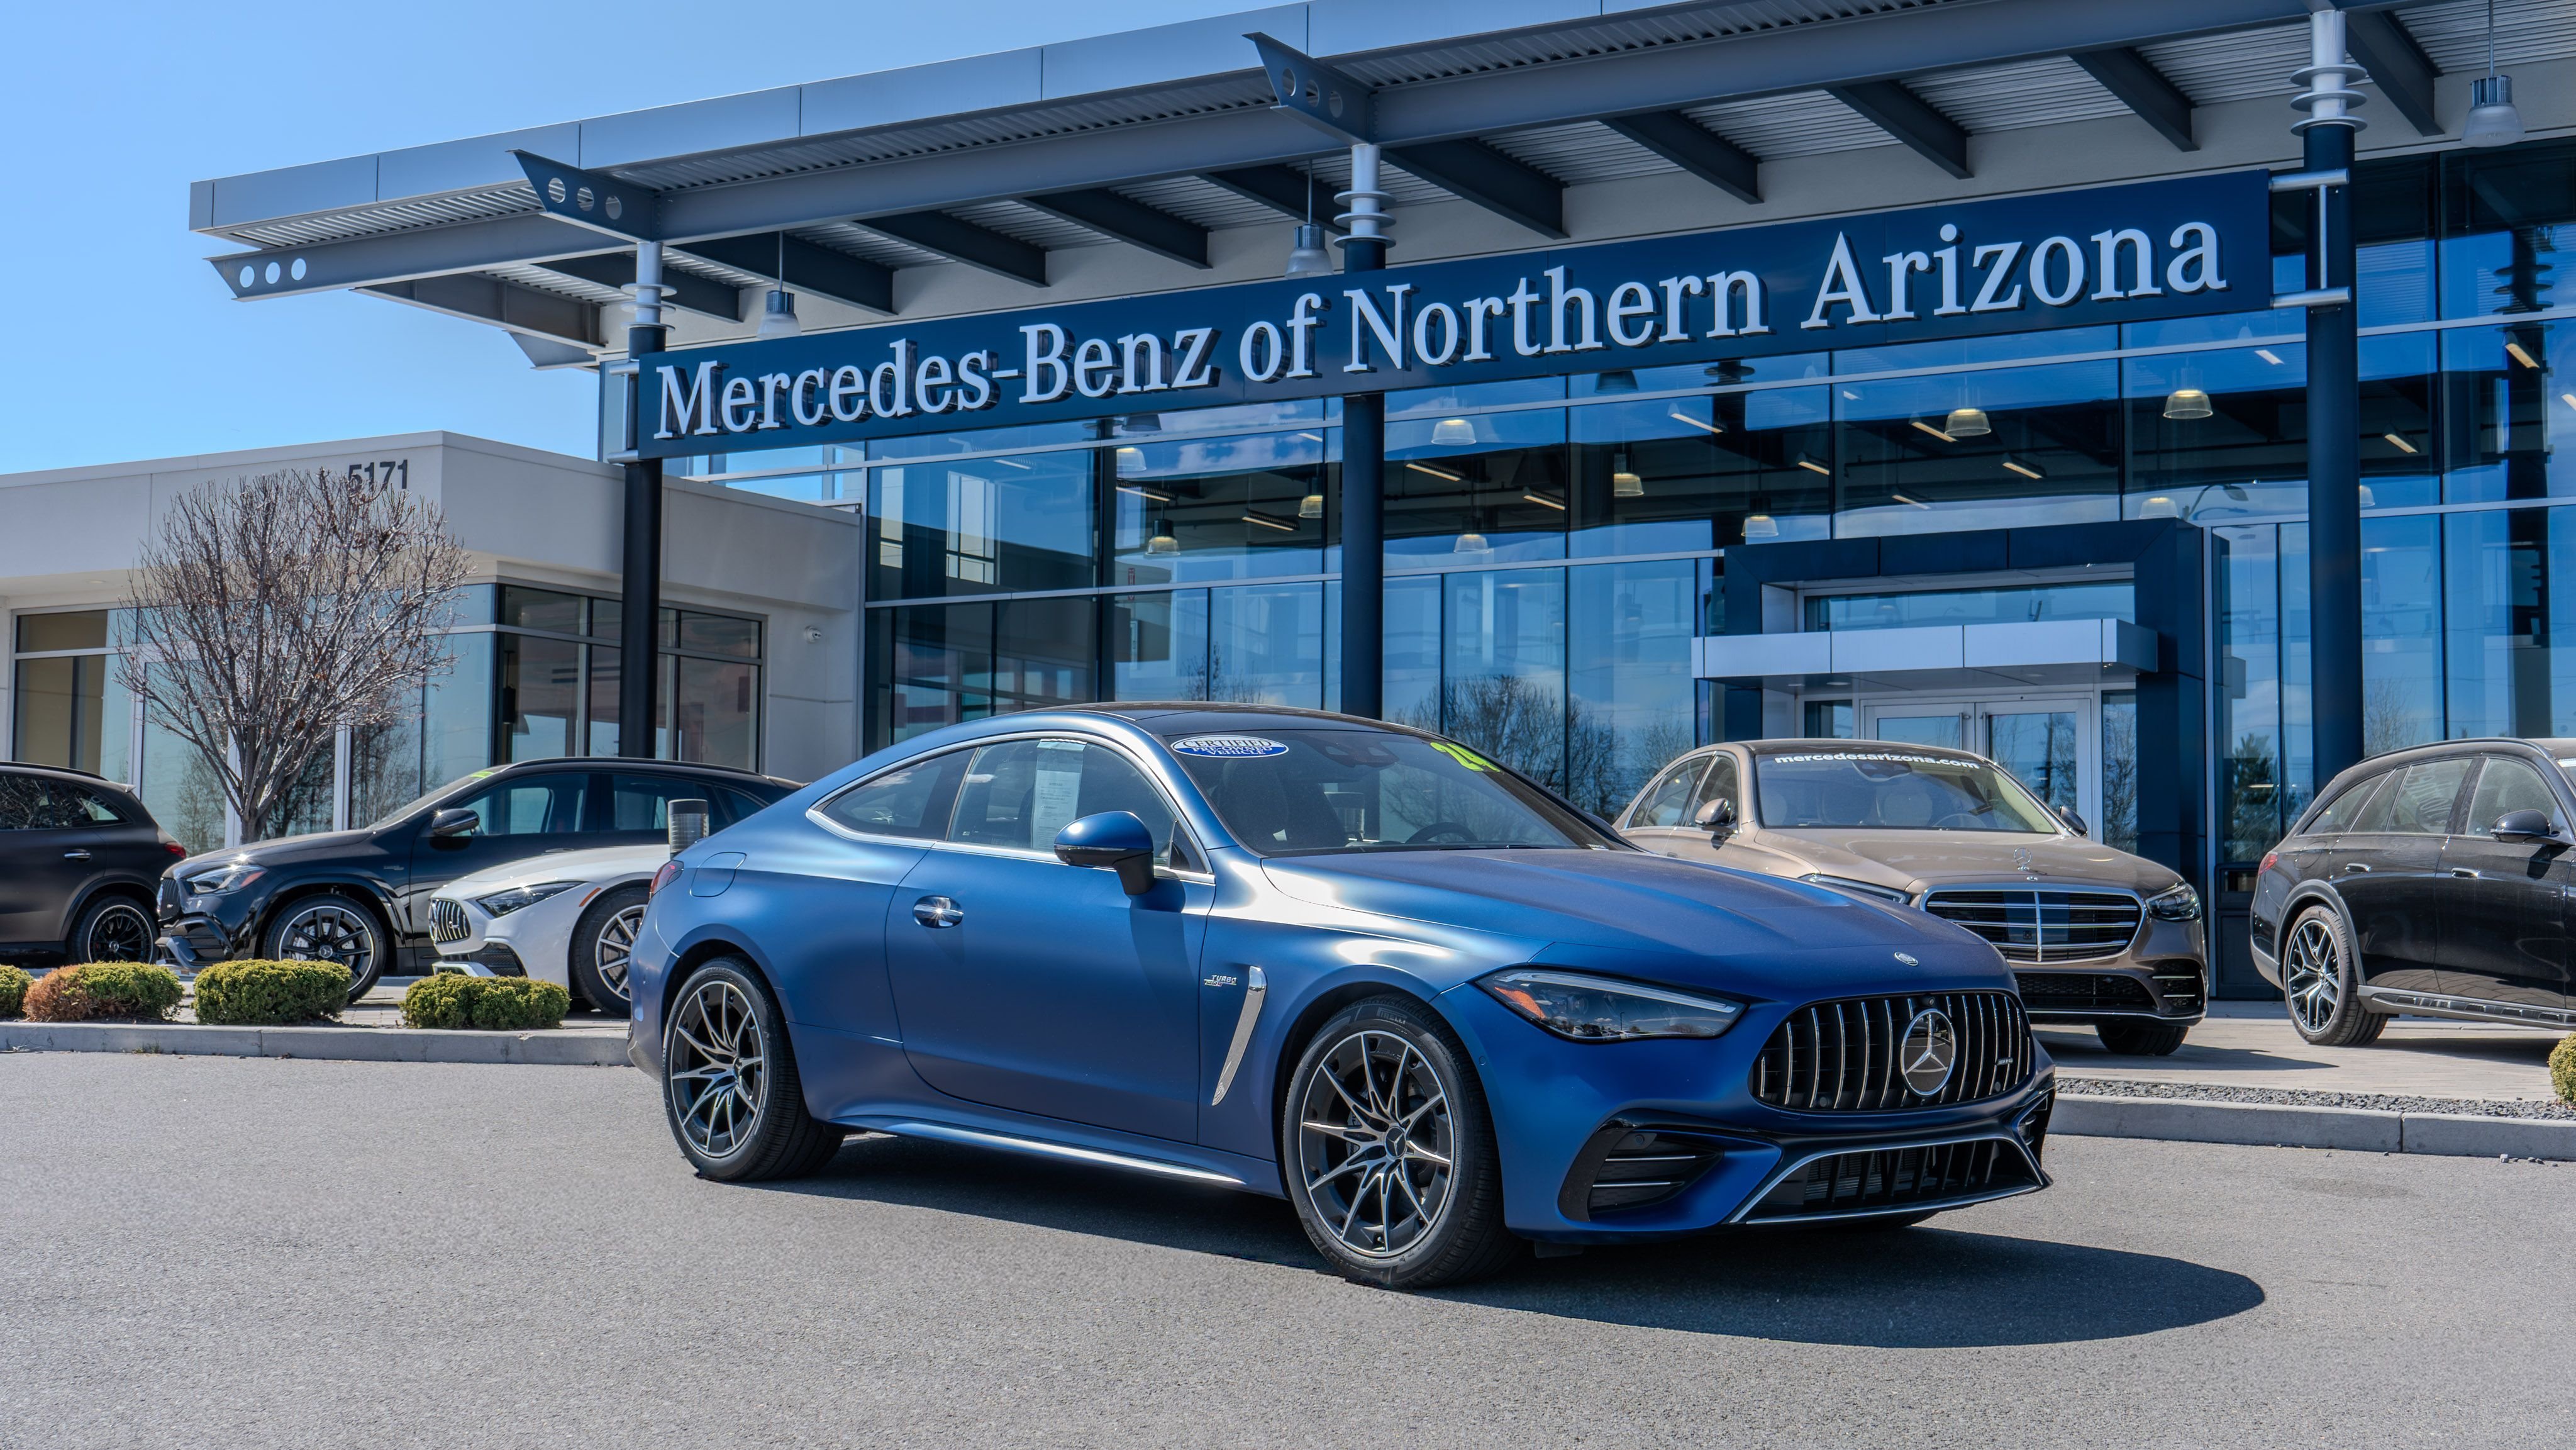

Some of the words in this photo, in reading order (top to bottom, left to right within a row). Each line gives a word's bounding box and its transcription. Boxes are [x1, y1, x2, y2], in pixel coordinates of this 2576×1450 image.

[653, 322, 1214, 439] Mercedes-Benz
[1239, 293, 1321, 382] of
[1343, 265, 1768, 373] Northern
[1800, 223, 2227, 328] Arizona
[348, 459, 408, 494] 5171
[1774, 752, 1980, 770] mercedesarizona.com
[1211, 974, 1237, 983] TURBO
[1376, 1007, 1407, 1025] PIRELLI
